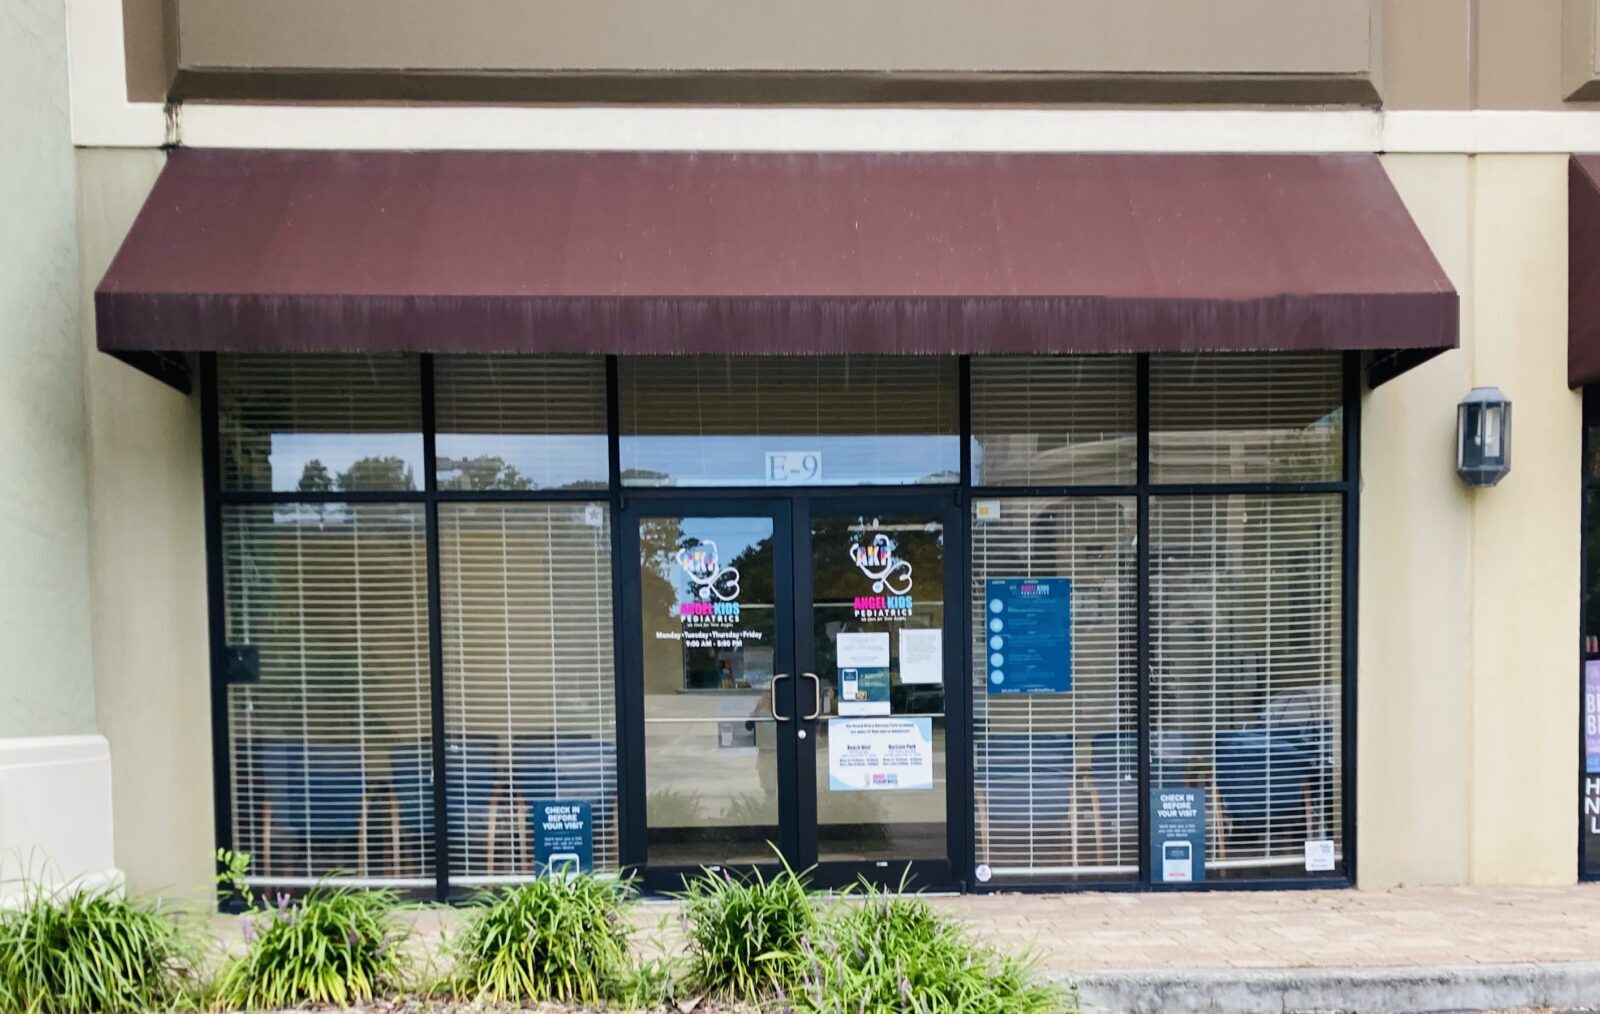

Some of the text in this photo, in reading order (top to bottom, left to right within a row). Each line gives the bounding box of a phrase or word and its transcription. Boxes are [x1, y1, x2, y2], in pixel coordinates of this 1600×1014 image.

[769, 454, 818, 481] E-9
[854, 595, 913, 609] ANGEL KIDS
[680, 602, 740, 615] ANGEL KIDS
[854, 608, 913, 617] PEDIATRICS
[681, 615, 740, 623] PEDIATRICS
[656, 630, 763, 640] Monday Tuesday Thursday Friday
[685, 640, 700, 648] 9:00
[701, 640, 712, 648] AM
[1160, 794, 1194, 802] CHECK IN
[544, 805, 580, 814] CHECK IN
[1162, 802, 1191, 810] BEFORE
[547, 814, 577, 822] BEFORE
[1157, 809, 1197, 818] YOUR VISIT
[542, 821, 584, 831] YOUR VISIT
